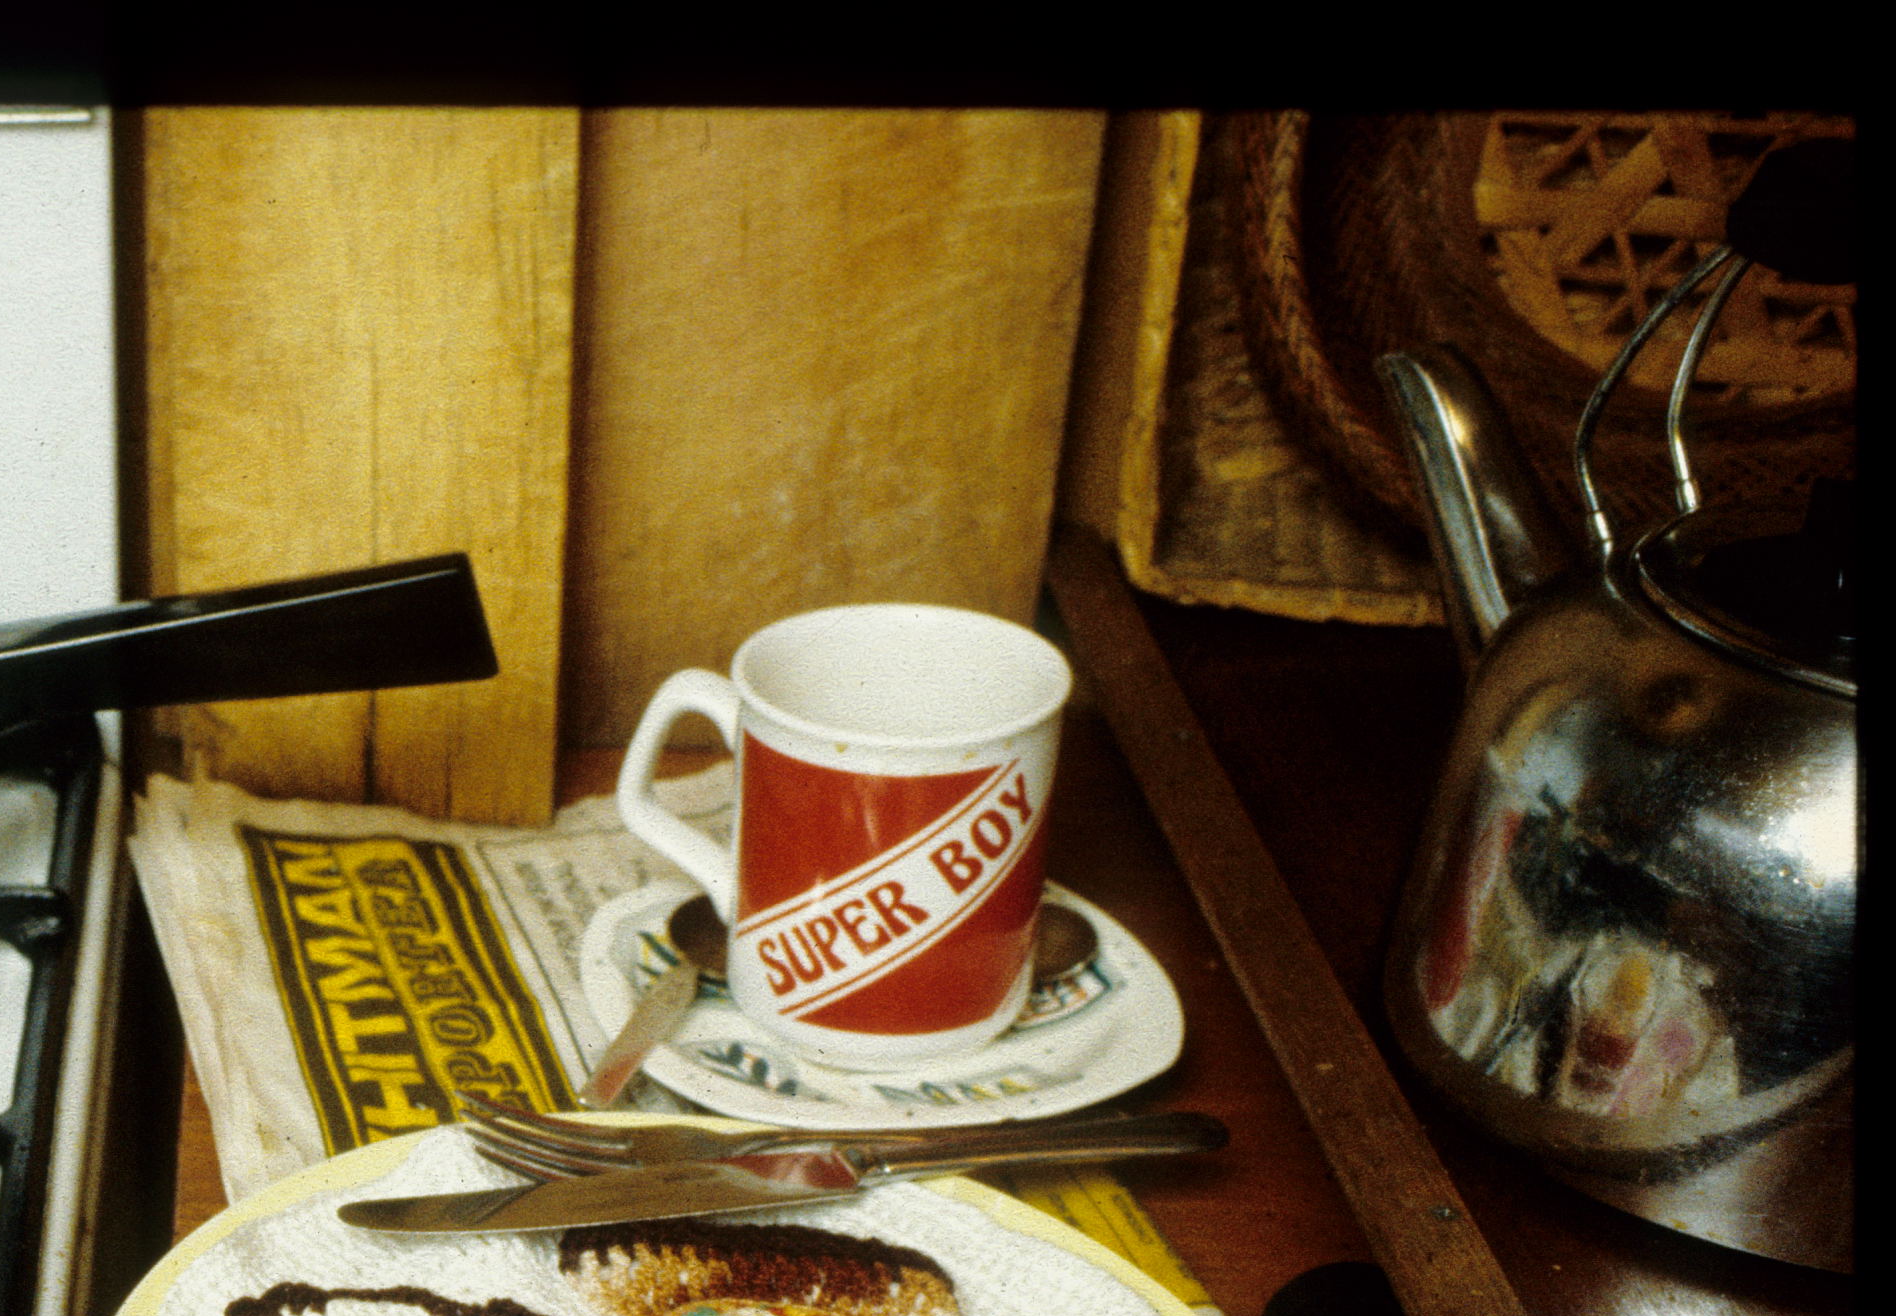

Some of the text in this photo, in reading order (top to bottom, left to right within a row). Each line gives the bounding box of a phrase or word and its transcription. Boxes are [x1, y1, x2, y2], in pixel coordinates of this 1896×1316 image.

[274, 839, 440, 1142] HITMAN
[756, 772, 1035, 997] SUPER BOY
